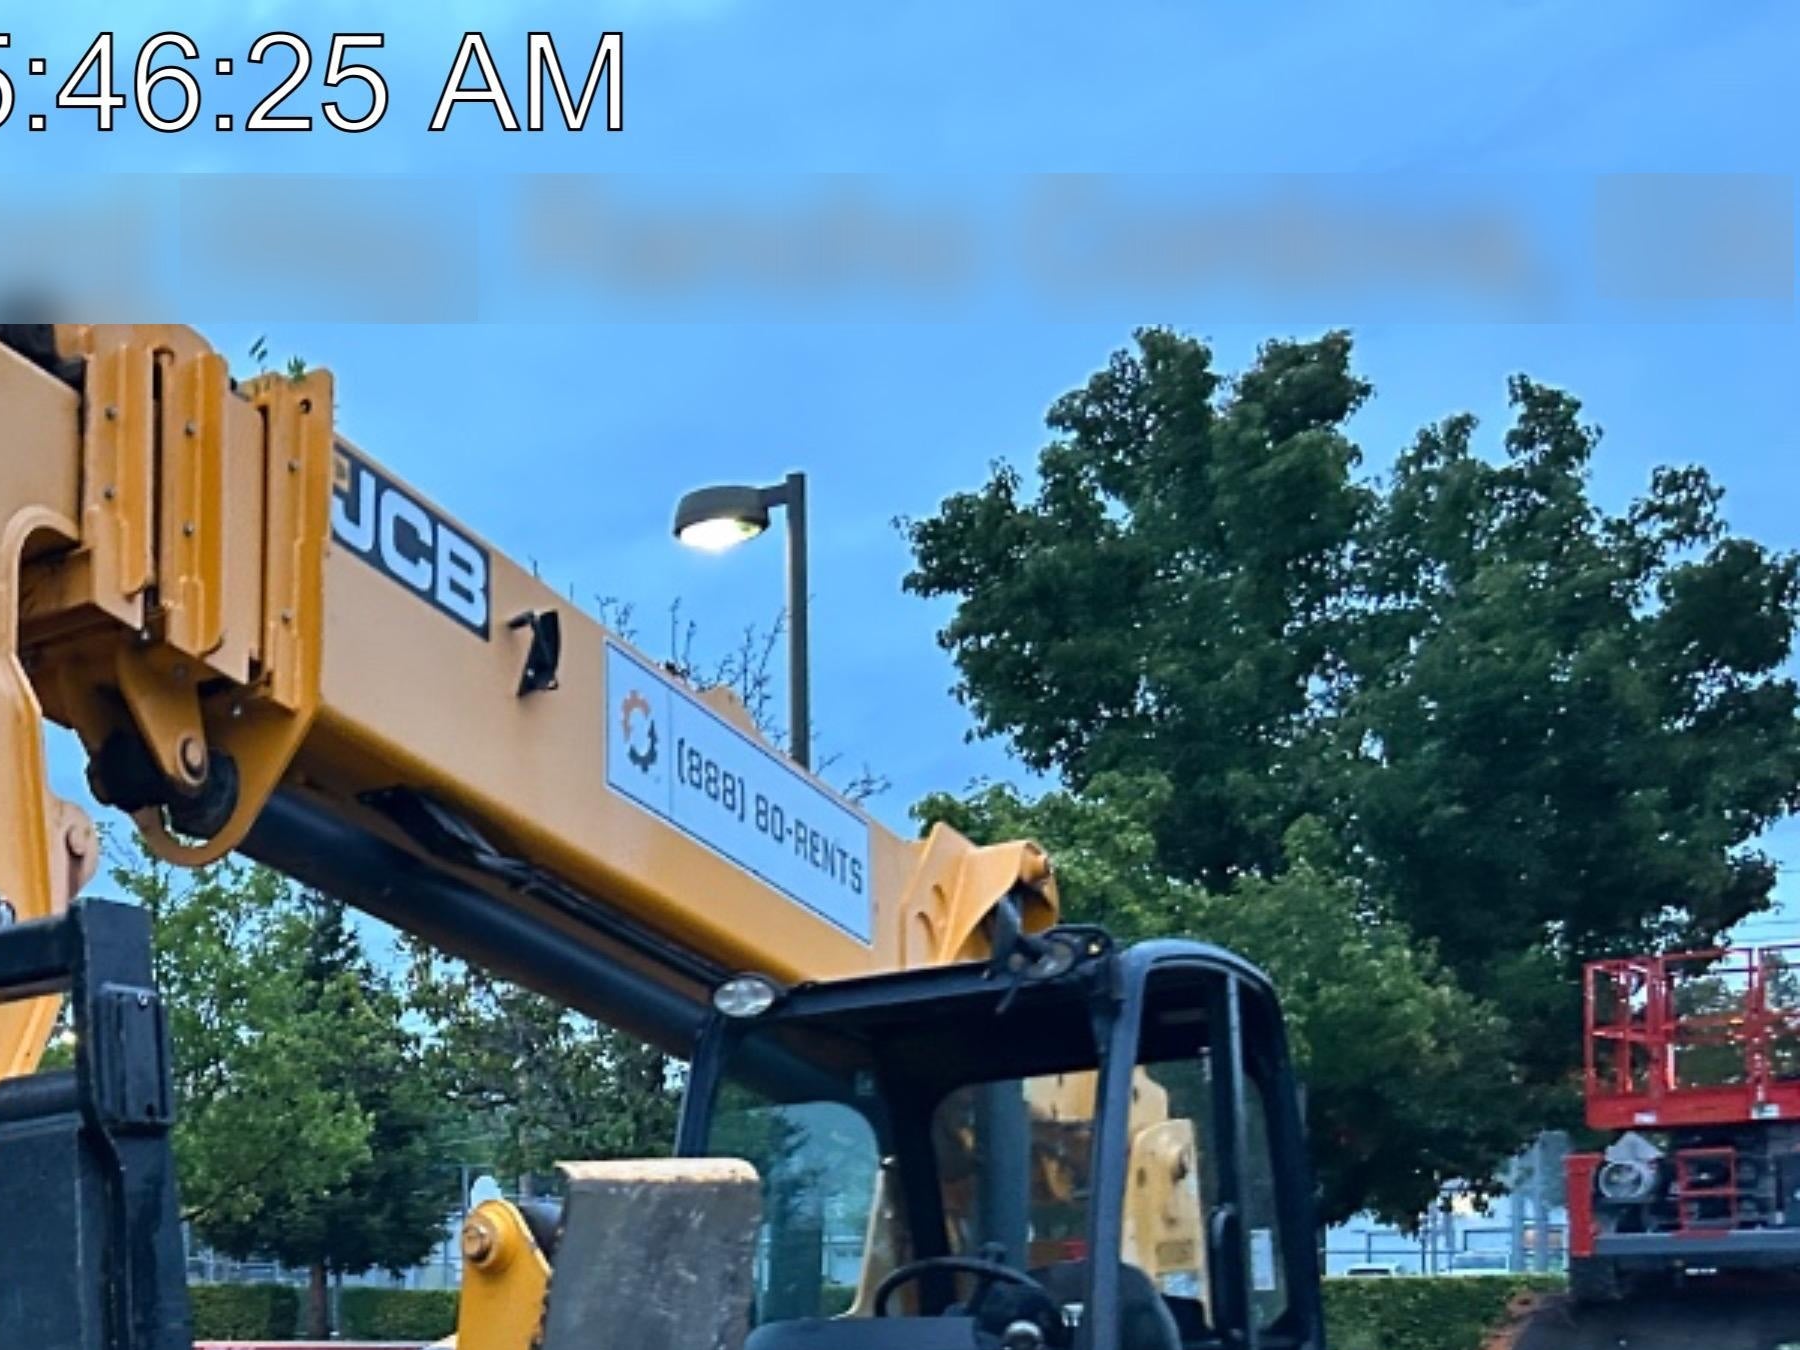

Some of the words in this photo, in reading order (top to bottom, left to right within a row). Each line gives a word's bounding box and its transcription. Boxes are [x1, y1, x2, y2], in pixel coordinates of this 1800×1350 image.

[331, 468, 488, 628] JCB
[677, 736, 746, 823] (888)
[755, 792, 863, 895] 80-RENTS
